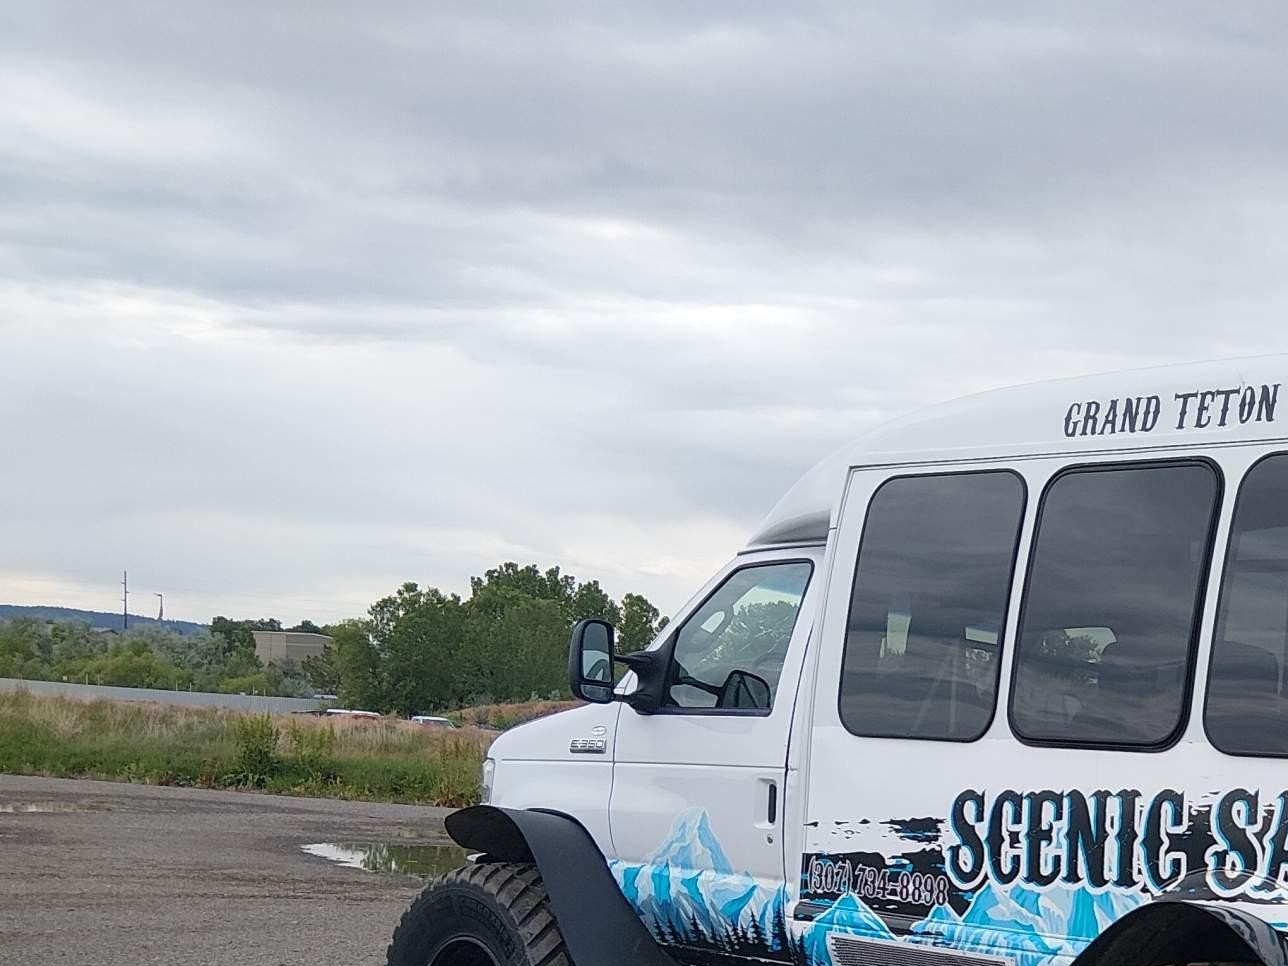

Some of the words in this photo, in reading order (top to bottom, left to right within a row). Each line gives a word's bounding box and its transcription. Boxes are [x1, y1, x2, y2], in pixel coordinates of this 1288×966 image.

[1064, 395, 1161, 438] GRAND
[1174, 381, 1281, 430] TETON
[945, 787, 1186, 894] SCENIC
[808, 855, 853, 897] (307)
[855, 863, 950, 907] 734-8898
